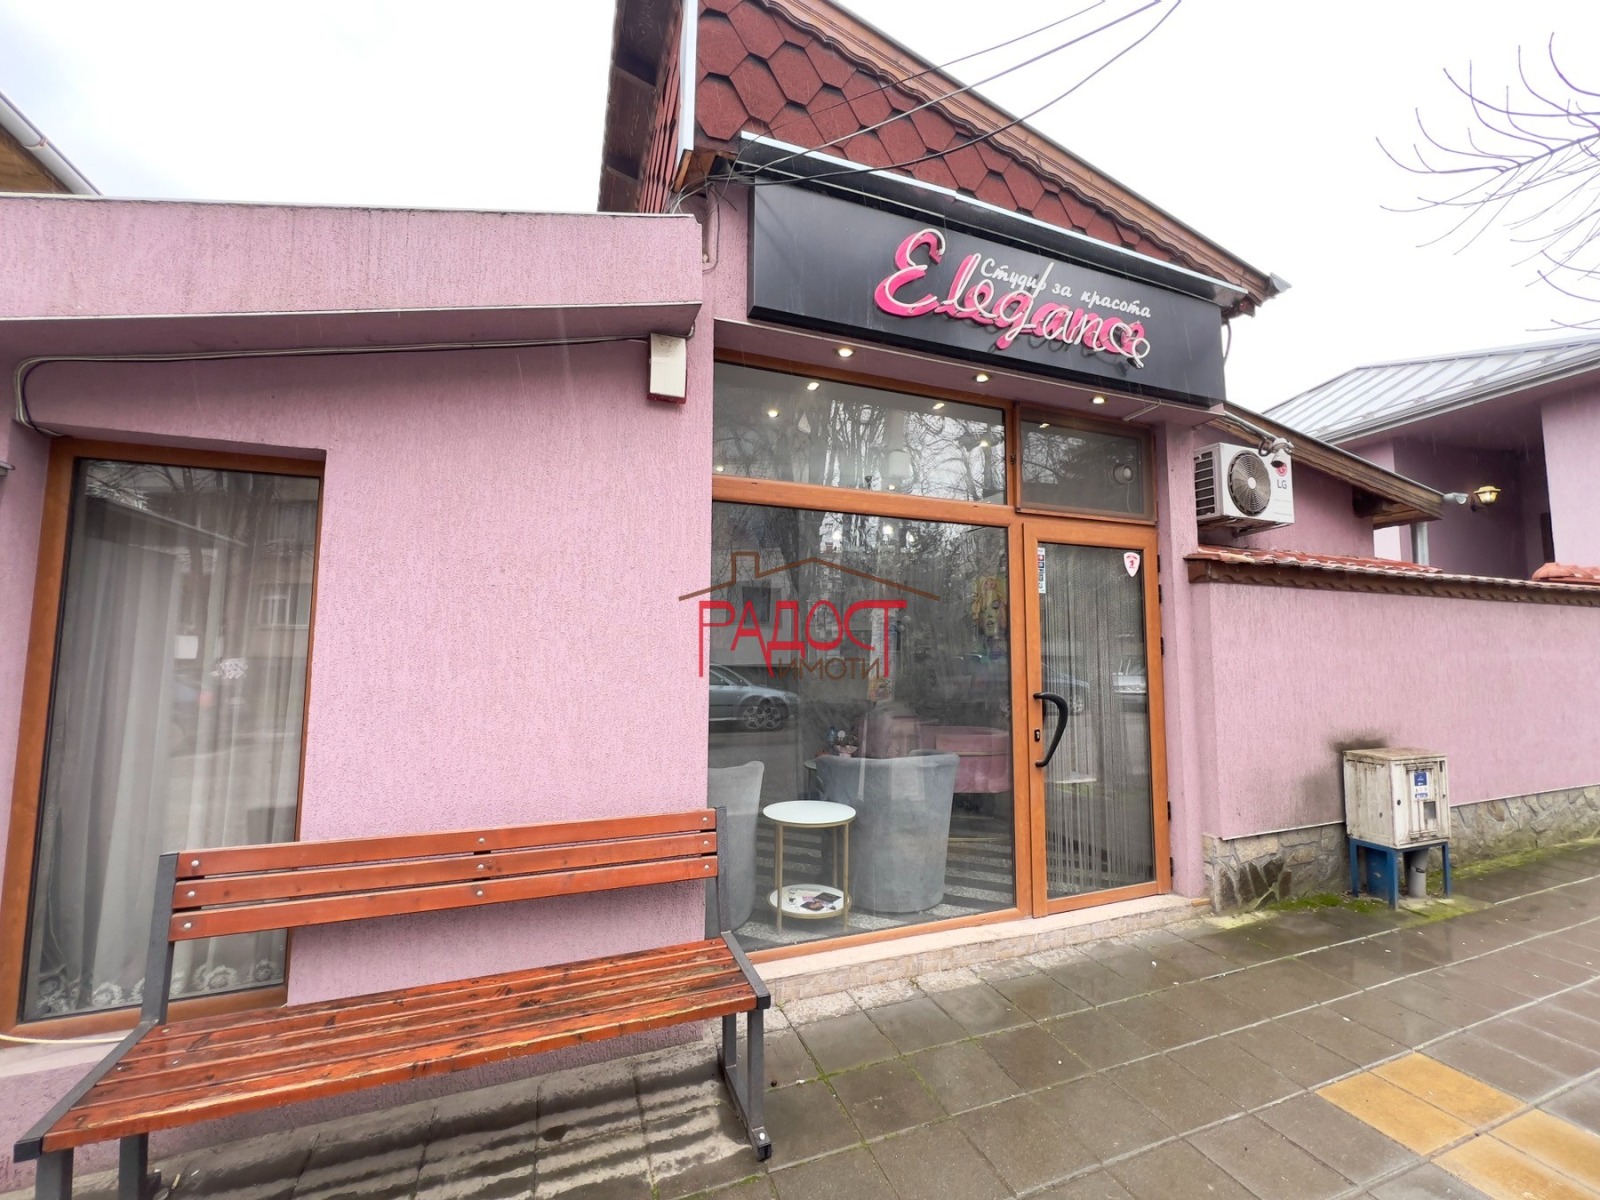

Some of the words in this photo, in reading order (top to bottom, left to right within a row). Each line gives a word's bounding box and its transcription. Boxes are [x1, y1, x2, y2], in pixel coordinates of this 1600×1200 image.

[873, 228, 1150, 366] Elegance
[1051, 283, 1073, 299] за
[1081, 290, 1151, 318] красота
[1276, 479, 1288, 490] LG
